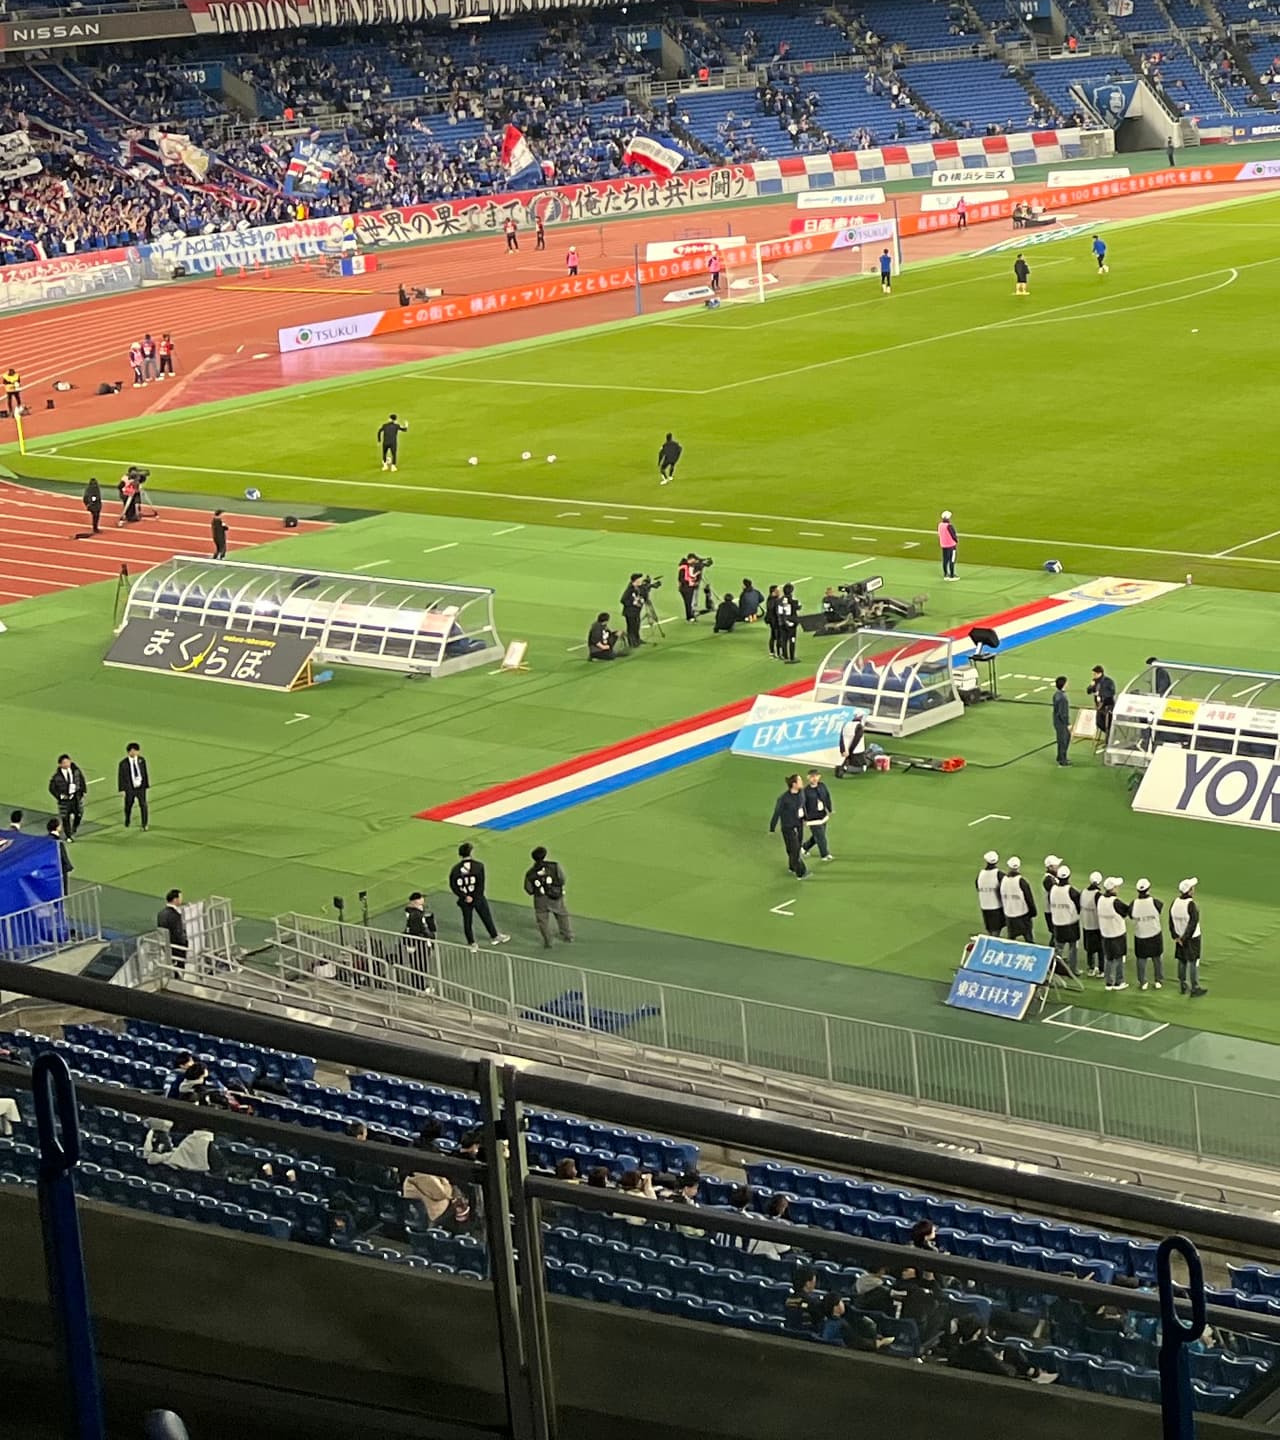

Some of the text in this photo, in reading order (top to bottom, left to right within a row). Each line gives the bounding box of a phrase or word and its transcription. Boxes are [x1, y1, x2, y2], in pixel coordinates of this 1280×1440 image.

[1020, 1, 1039, 13] N11
[13, 23, 100, 41] NISSAN
[627, 32, 648, 45] N12
[575, 169, 747, 217] 俺たちは共に闘う
[361, 201, 521, 246] 世界の果てまで
[316, 326, 358, 341] TSUKUI
[143, 628, 272, 679] まくらぼ
[753, 711, 850, 748] 日本工学院
[957, 980, 1023, 1007] 東京工科大学
